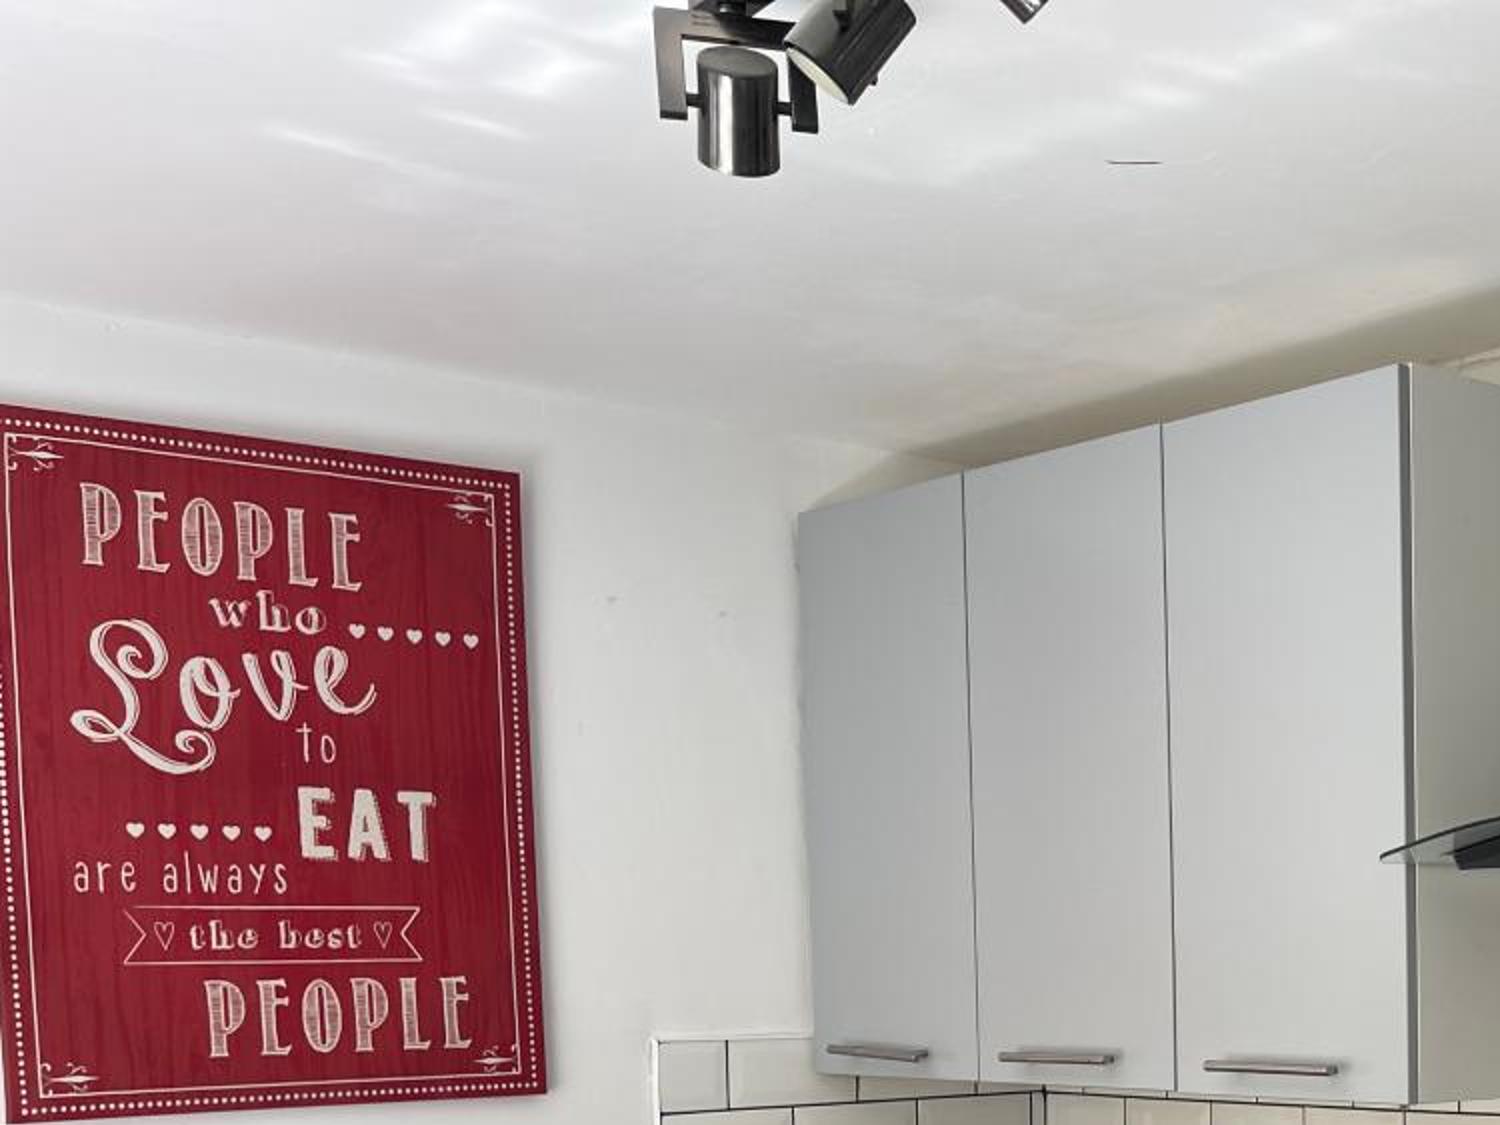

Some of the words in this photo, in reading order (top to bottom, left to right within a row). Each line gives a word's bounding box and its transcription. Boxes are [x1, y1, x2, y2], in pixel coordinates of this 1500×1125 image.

[79, 481, 364, 592] PEOPLE
[208, 589, 328, 635] who
[70, 617, 377, 775] Love
[296, 722, 337, 764] to
[297, 786, 437, 863] EAT
[73, 860, 137, 894] are
[162, 851, 289, 895] always
[189, 920, 259, 950] the
[278, 919, 364, 950] best
[204, 974, 474, 1059] PEOPLE
